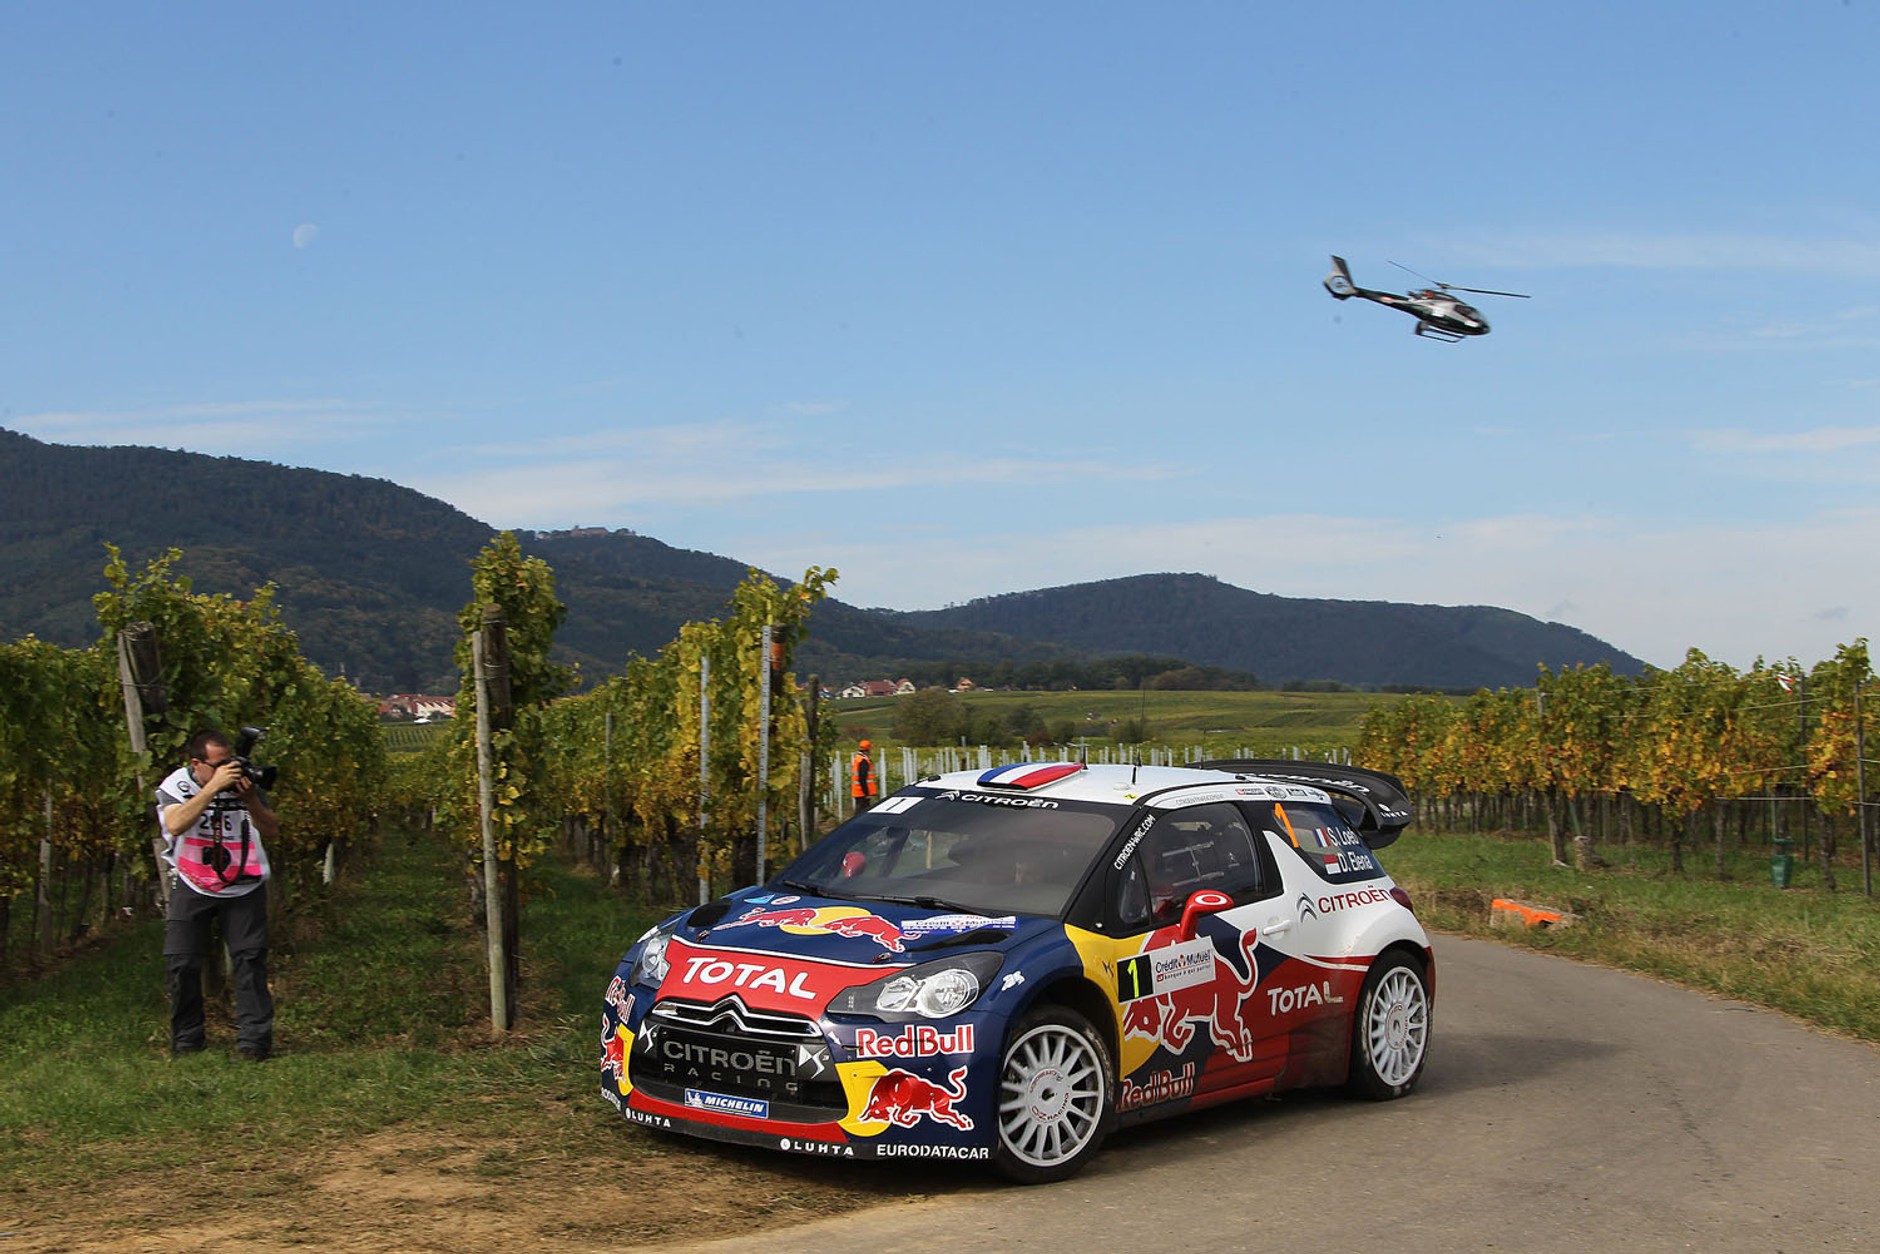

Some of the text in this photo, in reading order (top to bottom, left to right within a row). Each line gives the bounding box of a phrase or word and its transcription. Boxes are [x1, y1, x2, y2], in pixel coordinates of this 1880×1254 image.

[1274, 802, 1299, 848] 1
[1336, 826, 1360, 846] Loeb
[1338, 851, 1374, 872] D. Elena
[1318, 885, 1391, 914] CITROËN
[682, 957, 817, 1000] TOTAL
[1127, 958, 1139, 999] 1
[1267, 981, 1344, 1016] TOTAL
[856, 1024, 975, 1058] Red Bull
[663, 1041, 796, 1076] CITROËN
[1115, 1062, 1195, 1113] Red Bull
[632, 1111, 671, 1128] LUHTA
[704, 1096, 765, 1113] MICHELIN
[794, 1141, 854, 1156] LUHTA
[876, 1144, 989, 1160] EURODATACAR
